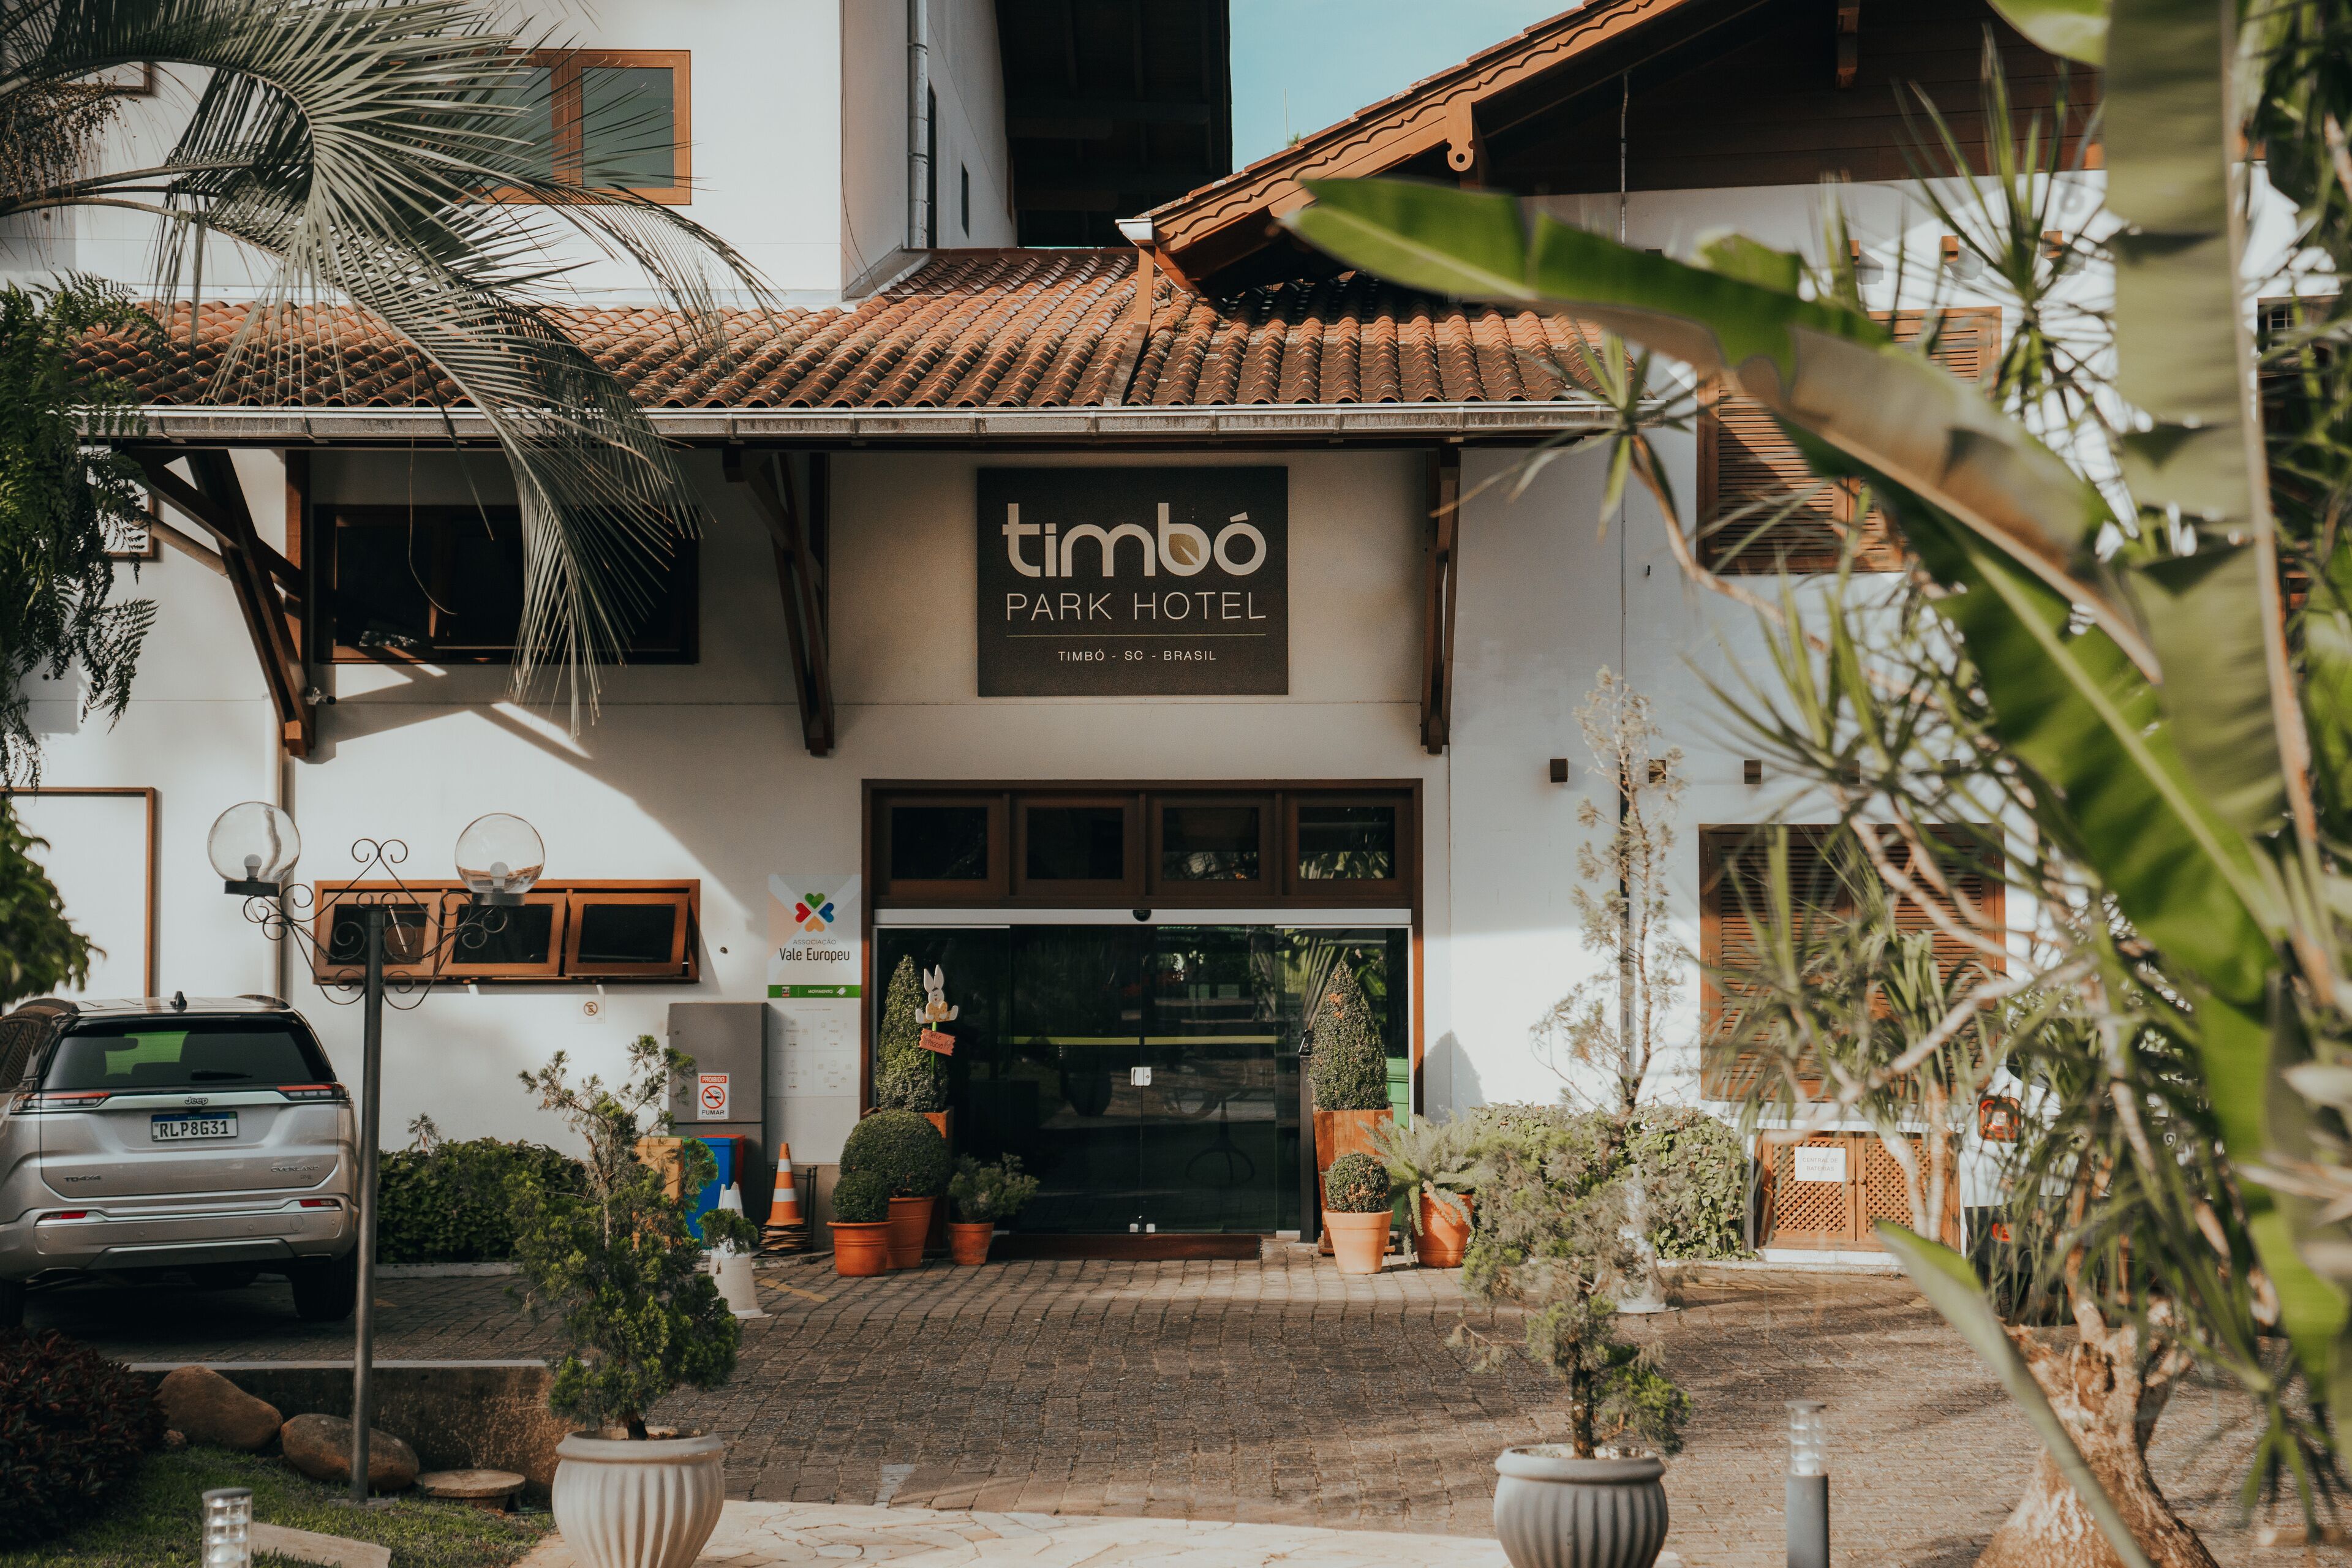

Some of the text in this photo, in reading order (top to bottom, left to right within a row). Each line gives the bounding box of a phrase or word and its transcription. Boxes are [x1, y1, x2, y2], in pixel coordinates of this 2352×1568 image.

[1002, 502, 1267, 577] timbó
[1006, 591, 1267, 621] PARK HOTEL
[1058, 648, 1104, 662] TIMBÓ
[1125, 650, 1144, 661] SC
[1164, 650, 1216, 662] BRASIL
[779, 948, 850, 963] Vale Europeu
[184, 1096, 208, 1106] Jeep
[159, 1120, 228, 1137] RLP8G31
